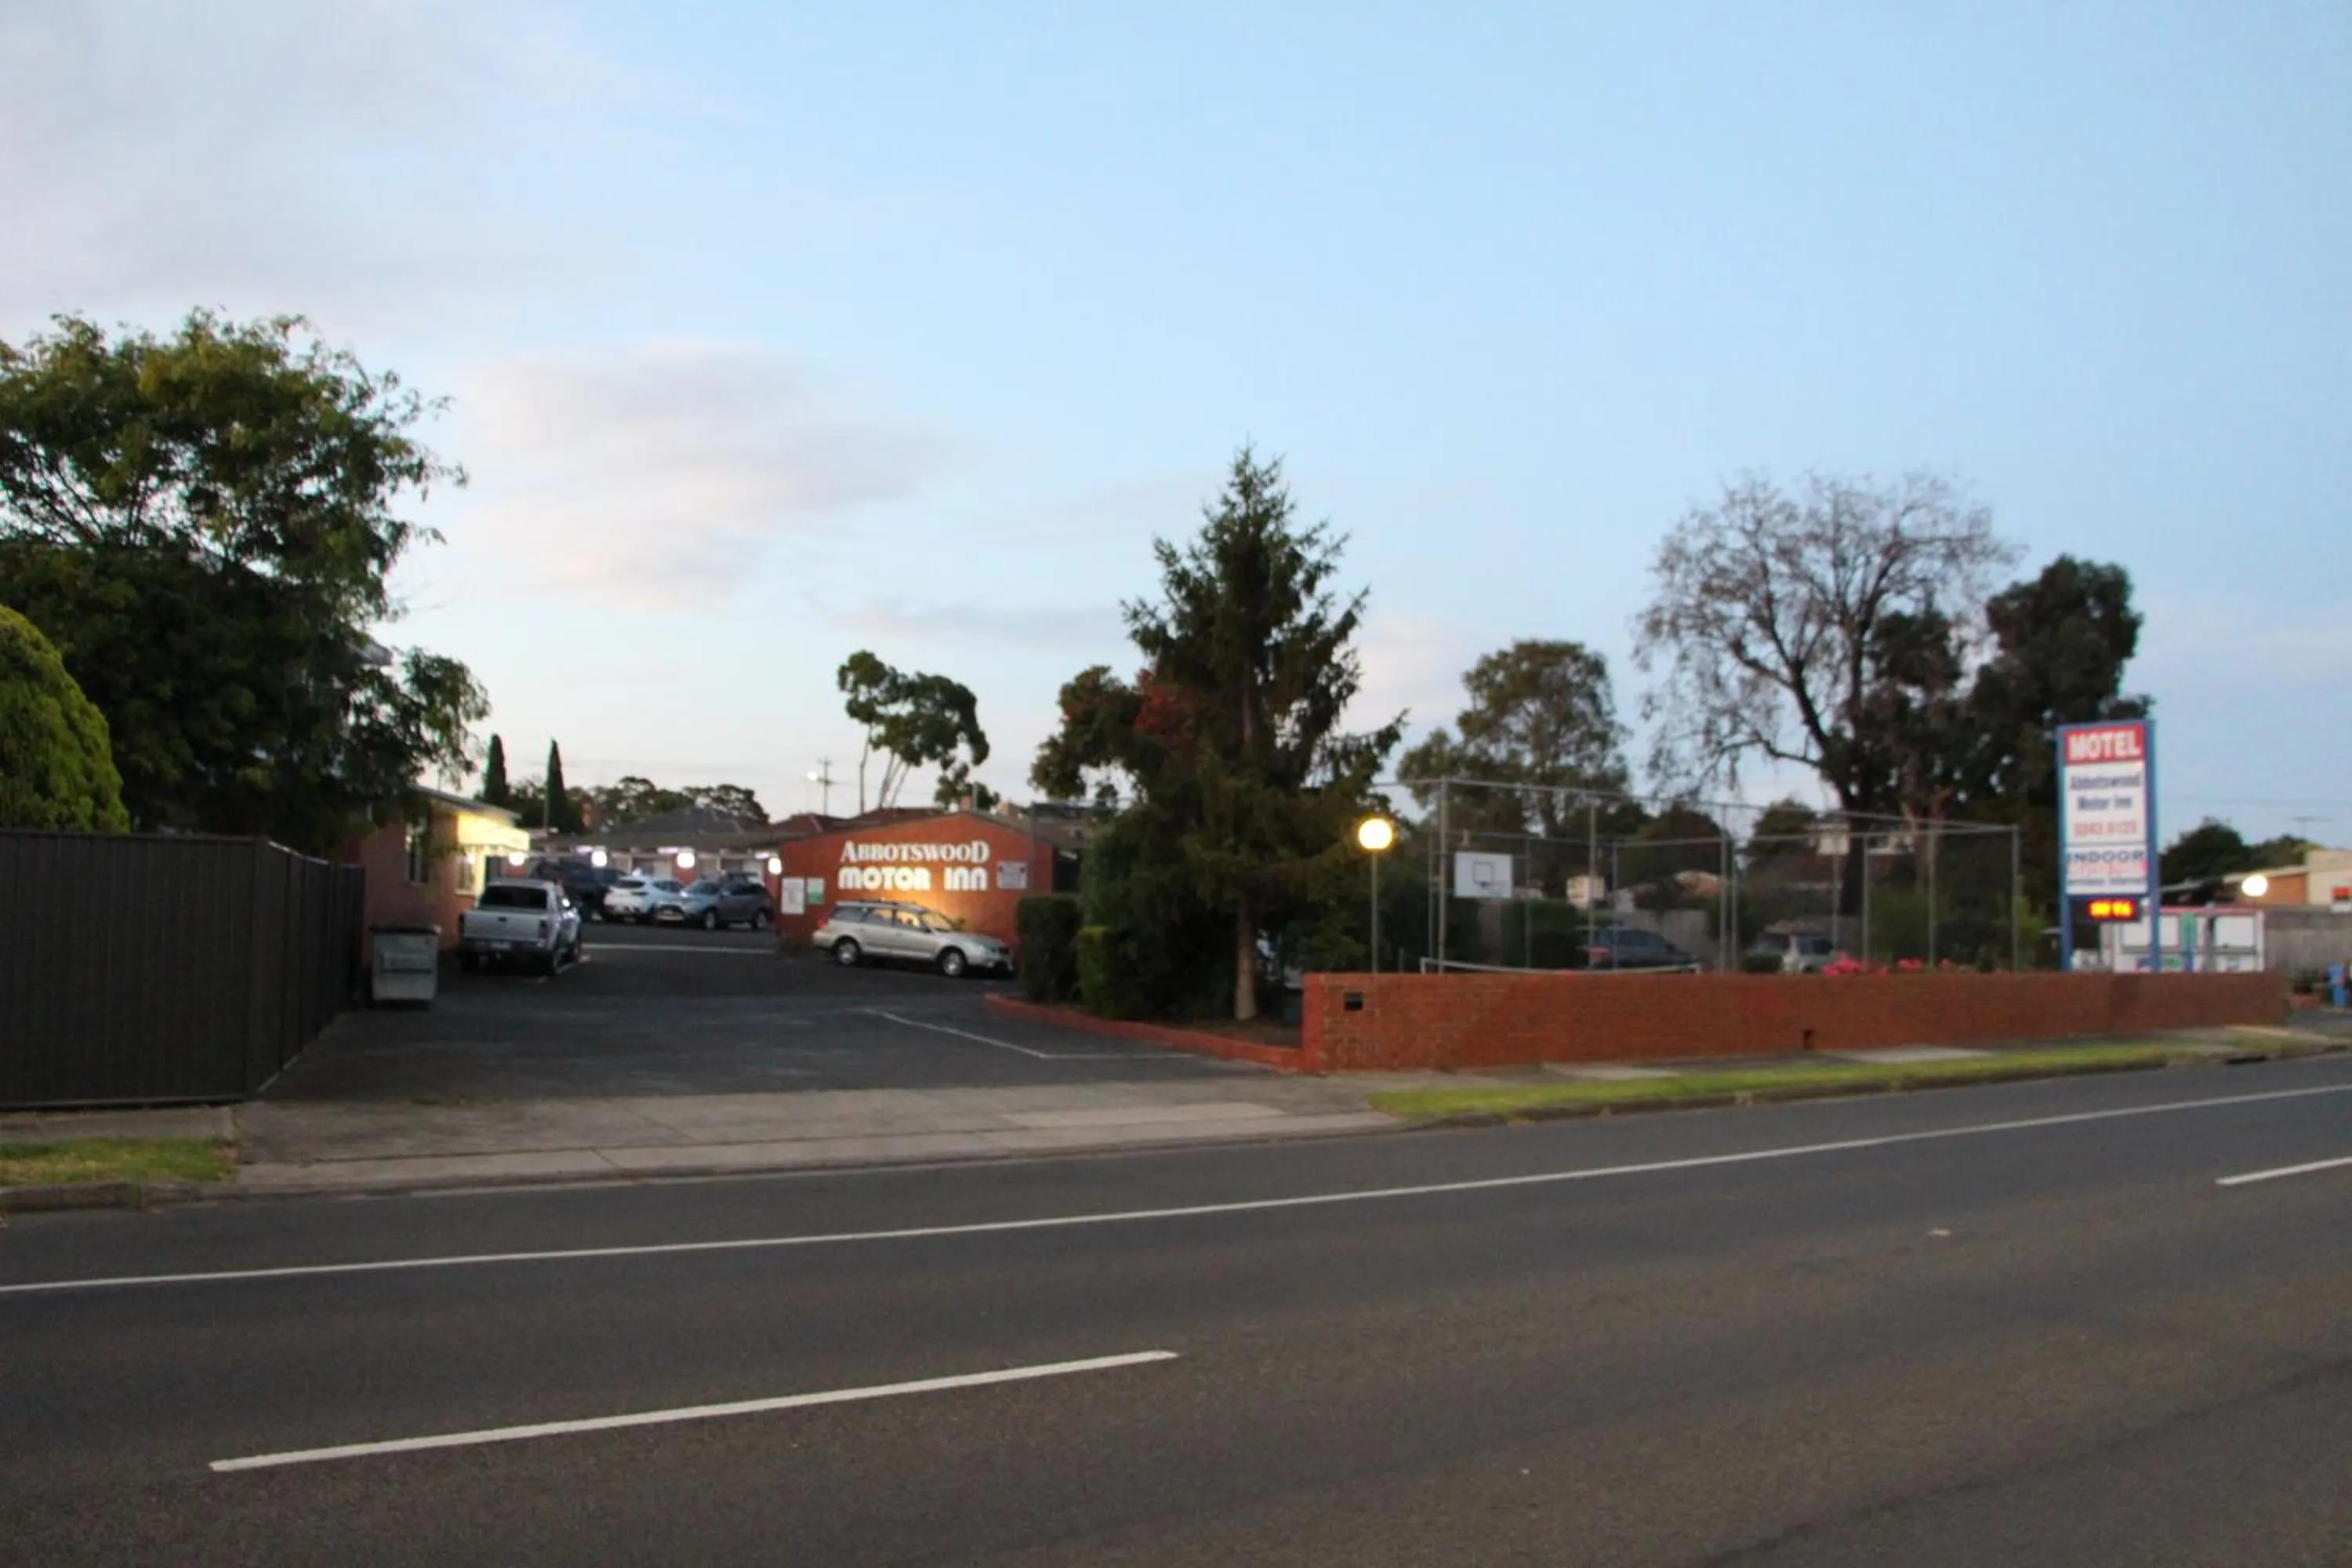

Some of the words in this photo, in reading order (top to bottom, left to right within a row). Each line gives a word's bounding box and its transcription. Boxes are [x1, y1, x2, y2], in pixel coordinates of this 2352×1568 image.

[2069, 731, 2141, 760] MOTEL
[840, 840, 990, 863] ABBOTSWOOD
[838, 866, 931, 891] MOTOR
